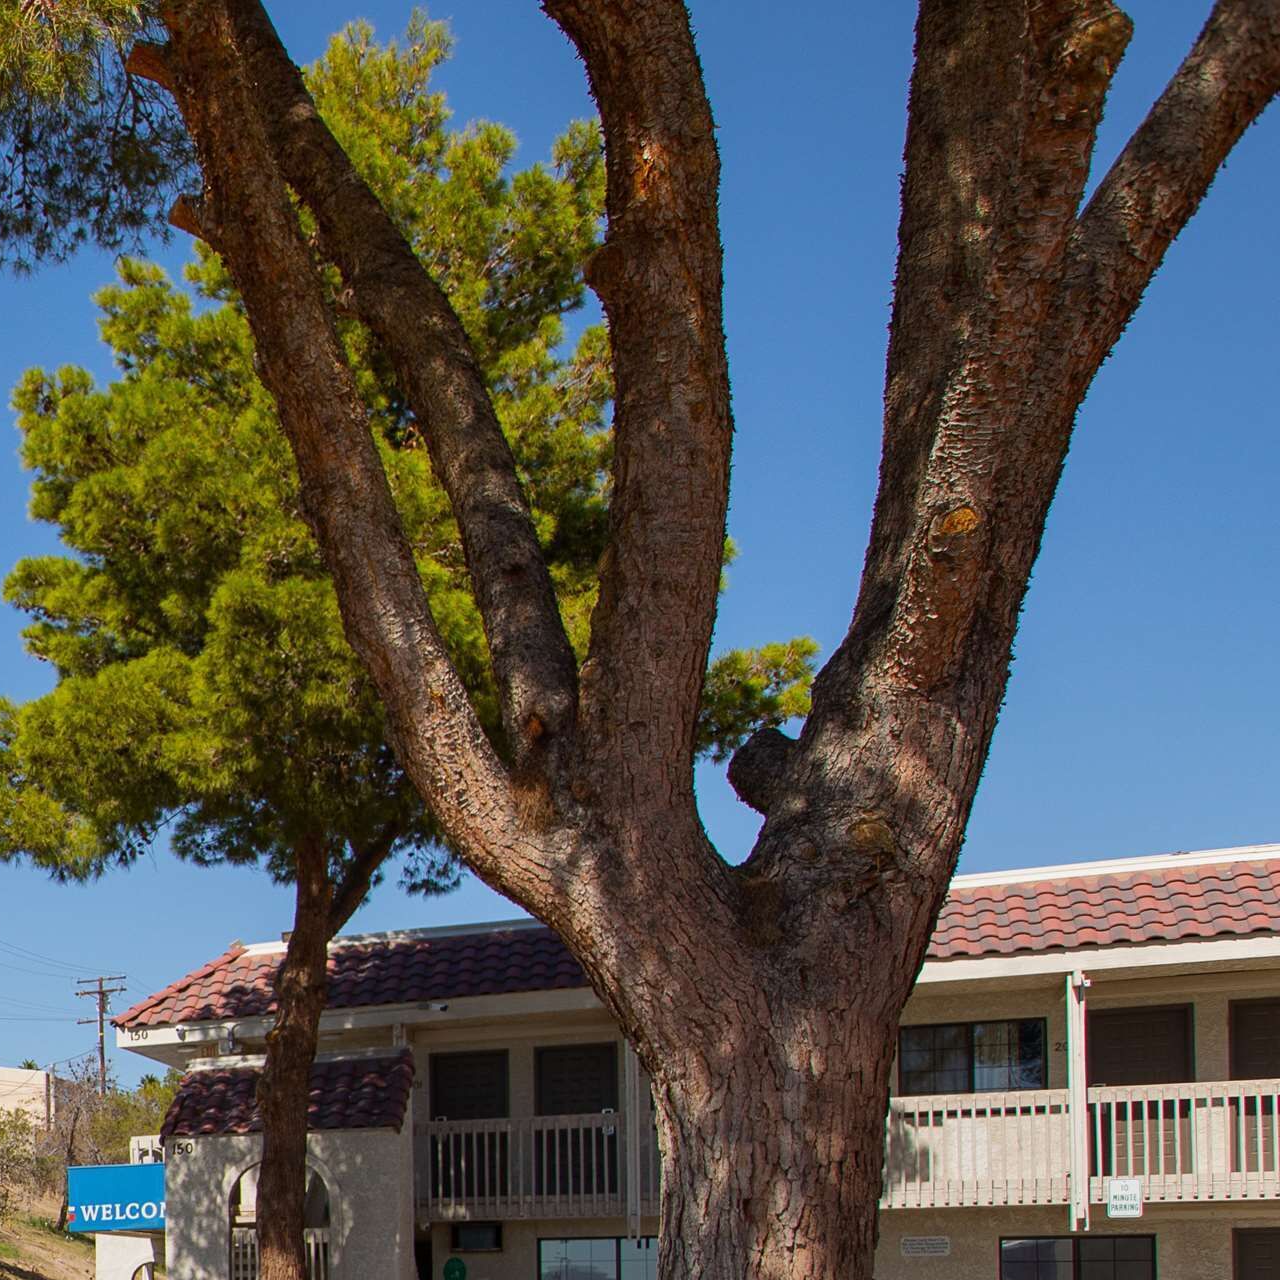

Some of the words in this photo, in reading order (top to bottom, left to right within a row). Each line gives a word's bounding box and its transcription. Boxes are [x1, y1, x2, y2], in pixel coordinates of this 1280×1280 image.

[129, 1029, 149, 1042] 150
[172, 1142, 194, 1156] 150
[1112, 1193, 1137, 1202] MINUTE
[80, 1202, 166, 1222] WELCO
[1110, 1203, 1139, 1212] PARKING
